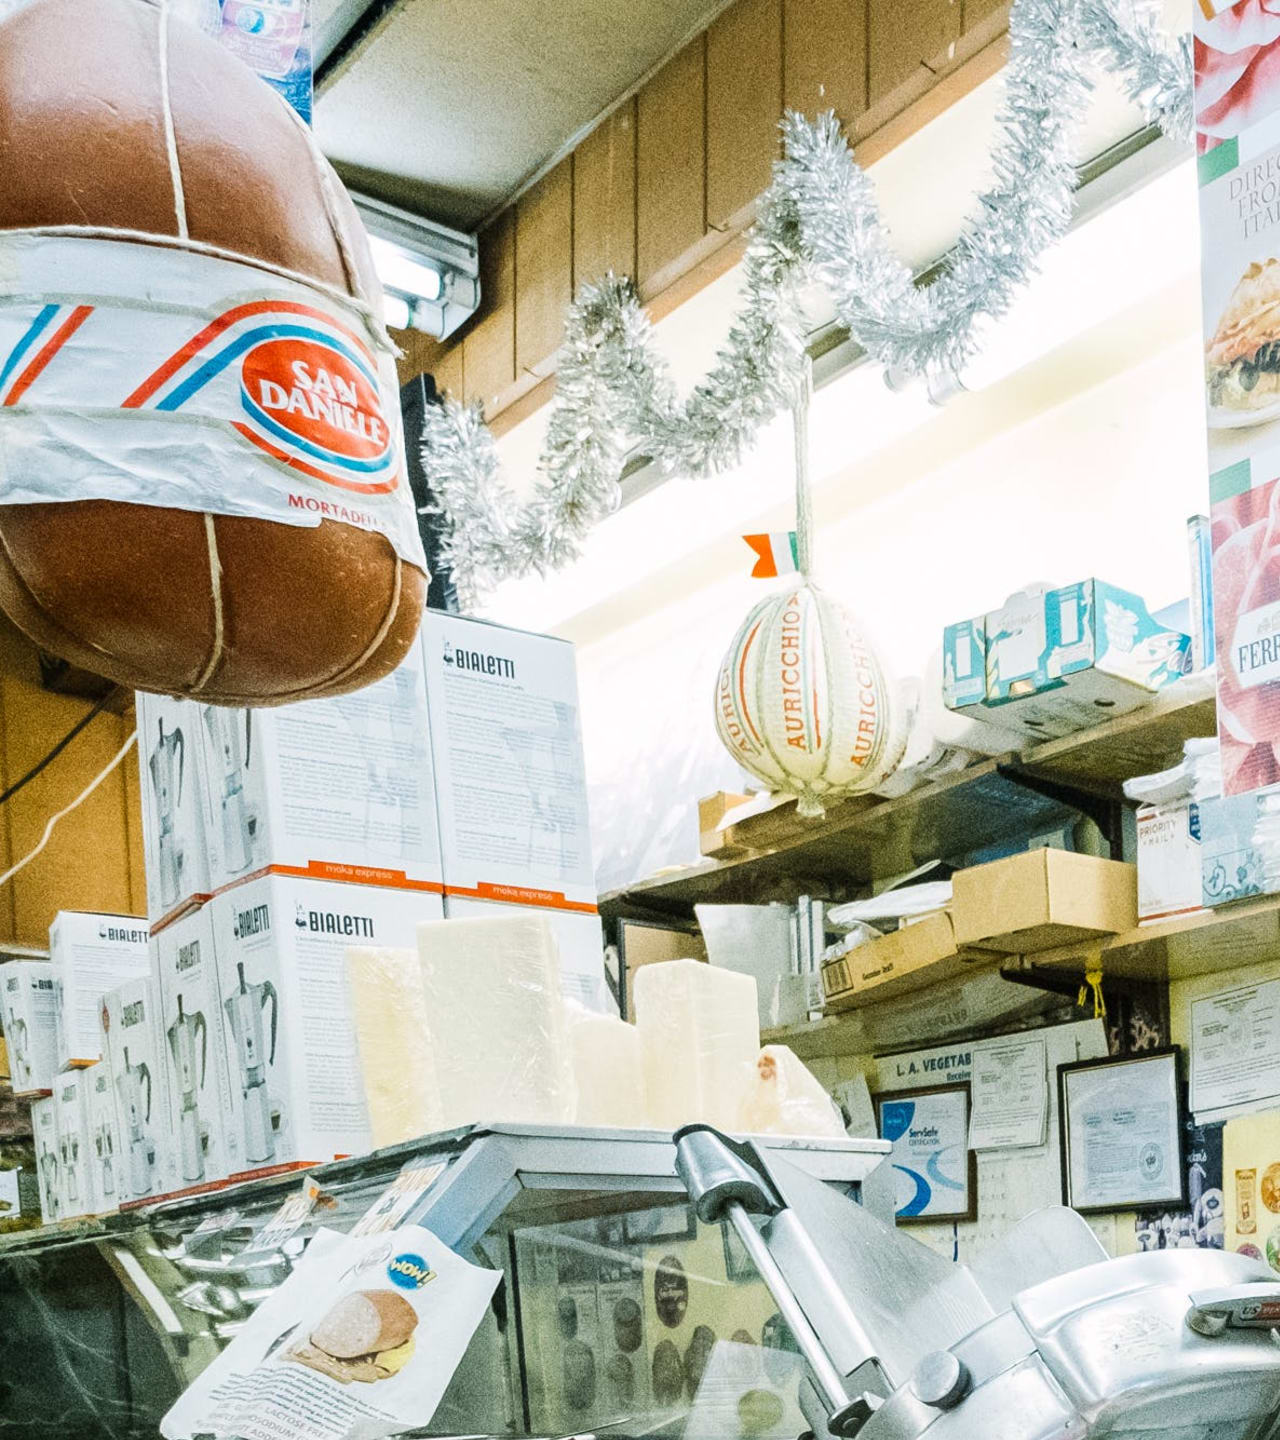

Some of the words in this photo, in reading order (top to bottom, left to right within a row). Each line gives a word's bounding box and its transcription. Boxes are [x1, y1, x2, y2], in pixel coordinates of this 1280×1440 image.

[291, 360, 358, 408] SAN
[259, 379, 385, 447] DANIELE
[288, 494, 387, 528] MORTADELL
[781, 610, 807, 751] AURICCHIO
[325, 863, 352, 876] moka
[354, 867, 393, 880] express
[493, 886, 517, 898] moka
[519, 889, 554, 902] express
[108, 928, 150, 943] BIALETT
[896, 1064, 905, 1077] L.
[909, 1063, 920, 1075] A.
[909, 1126, 938, 1138] ServSafe
[390, 1258, 438, 1289] WOW!
[1241, 1305, 1260, 1316] US
[264, 1406, 305, 1430] LACTOSE
